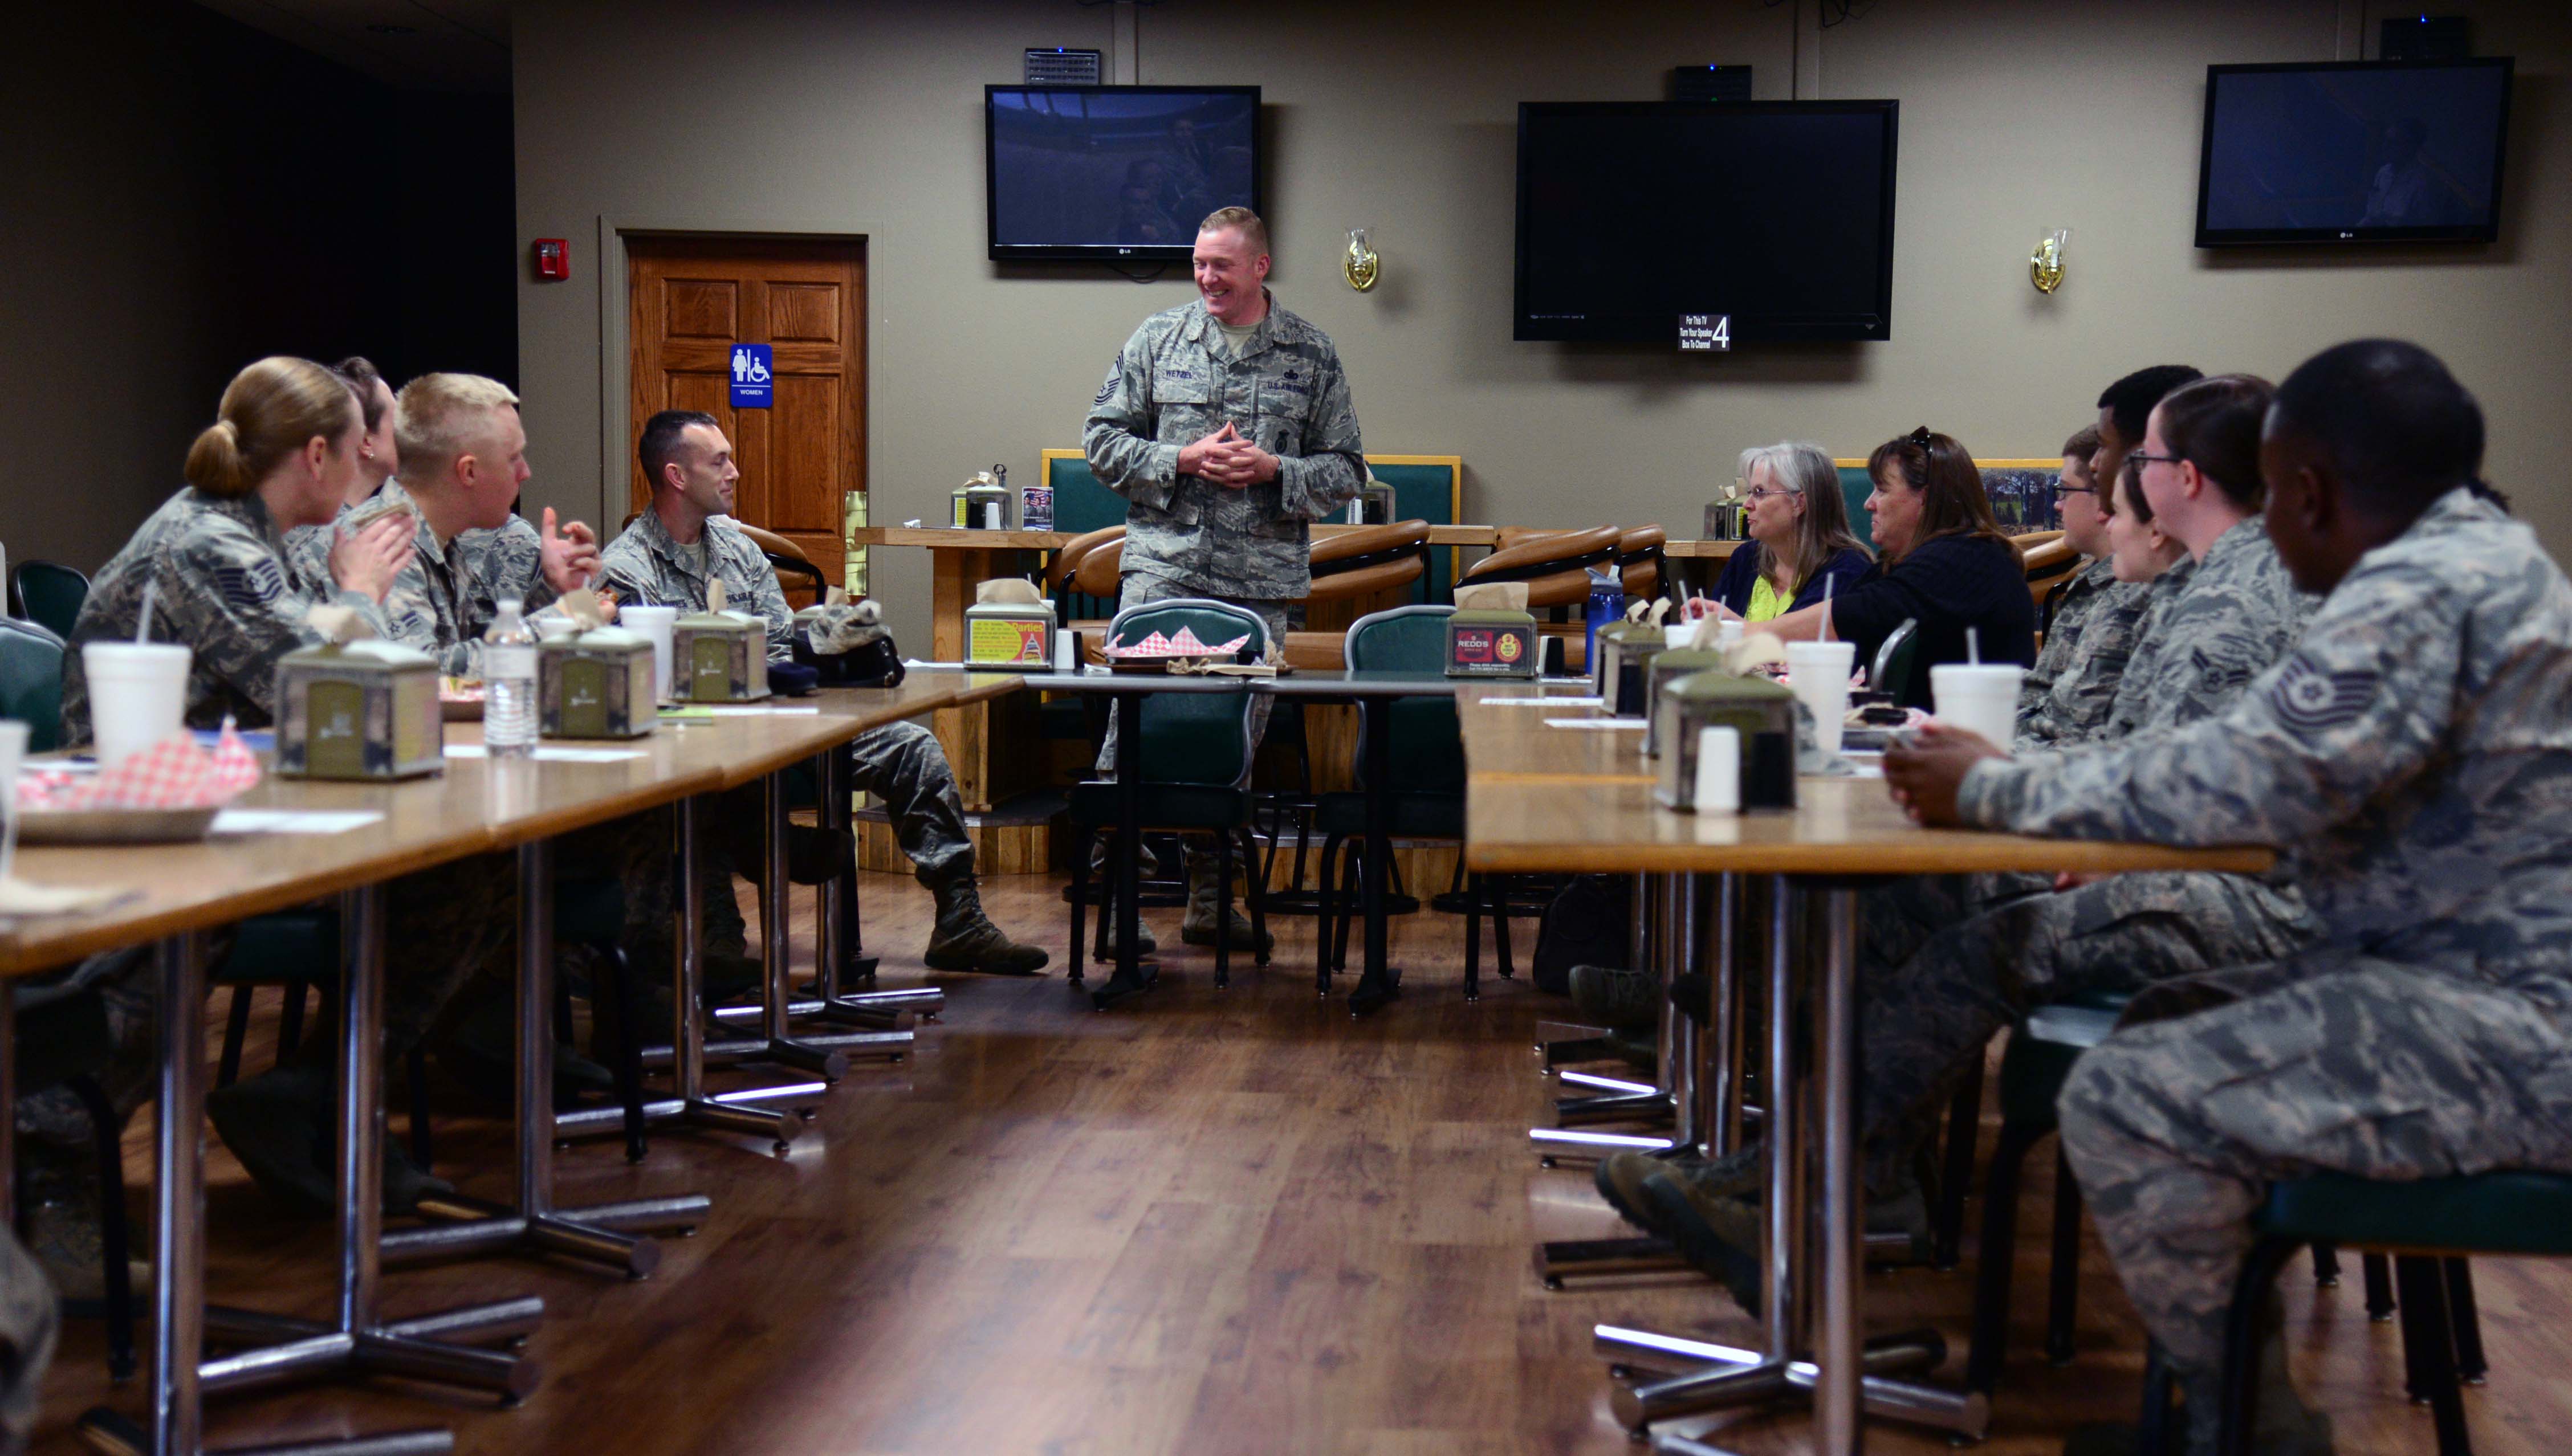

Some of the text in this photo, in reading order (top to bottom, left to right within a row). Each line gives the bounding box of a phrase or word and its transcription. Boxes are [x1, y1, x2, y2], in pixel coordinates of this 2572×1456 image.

[1702, 316, 1707, 325] TV
[1680, 328, 1712, 338] Turn Your Speaker
[1712, 317, 1729, 348] 4
[1690, 340, 1695, 348] To
[1695, 340, 1710, 348] Channel
[1166, 369, 1193, 378] WETZEL
[1268, 381, 1280, 390] U.S.
[1012, 622, 1043, 632] Parties
